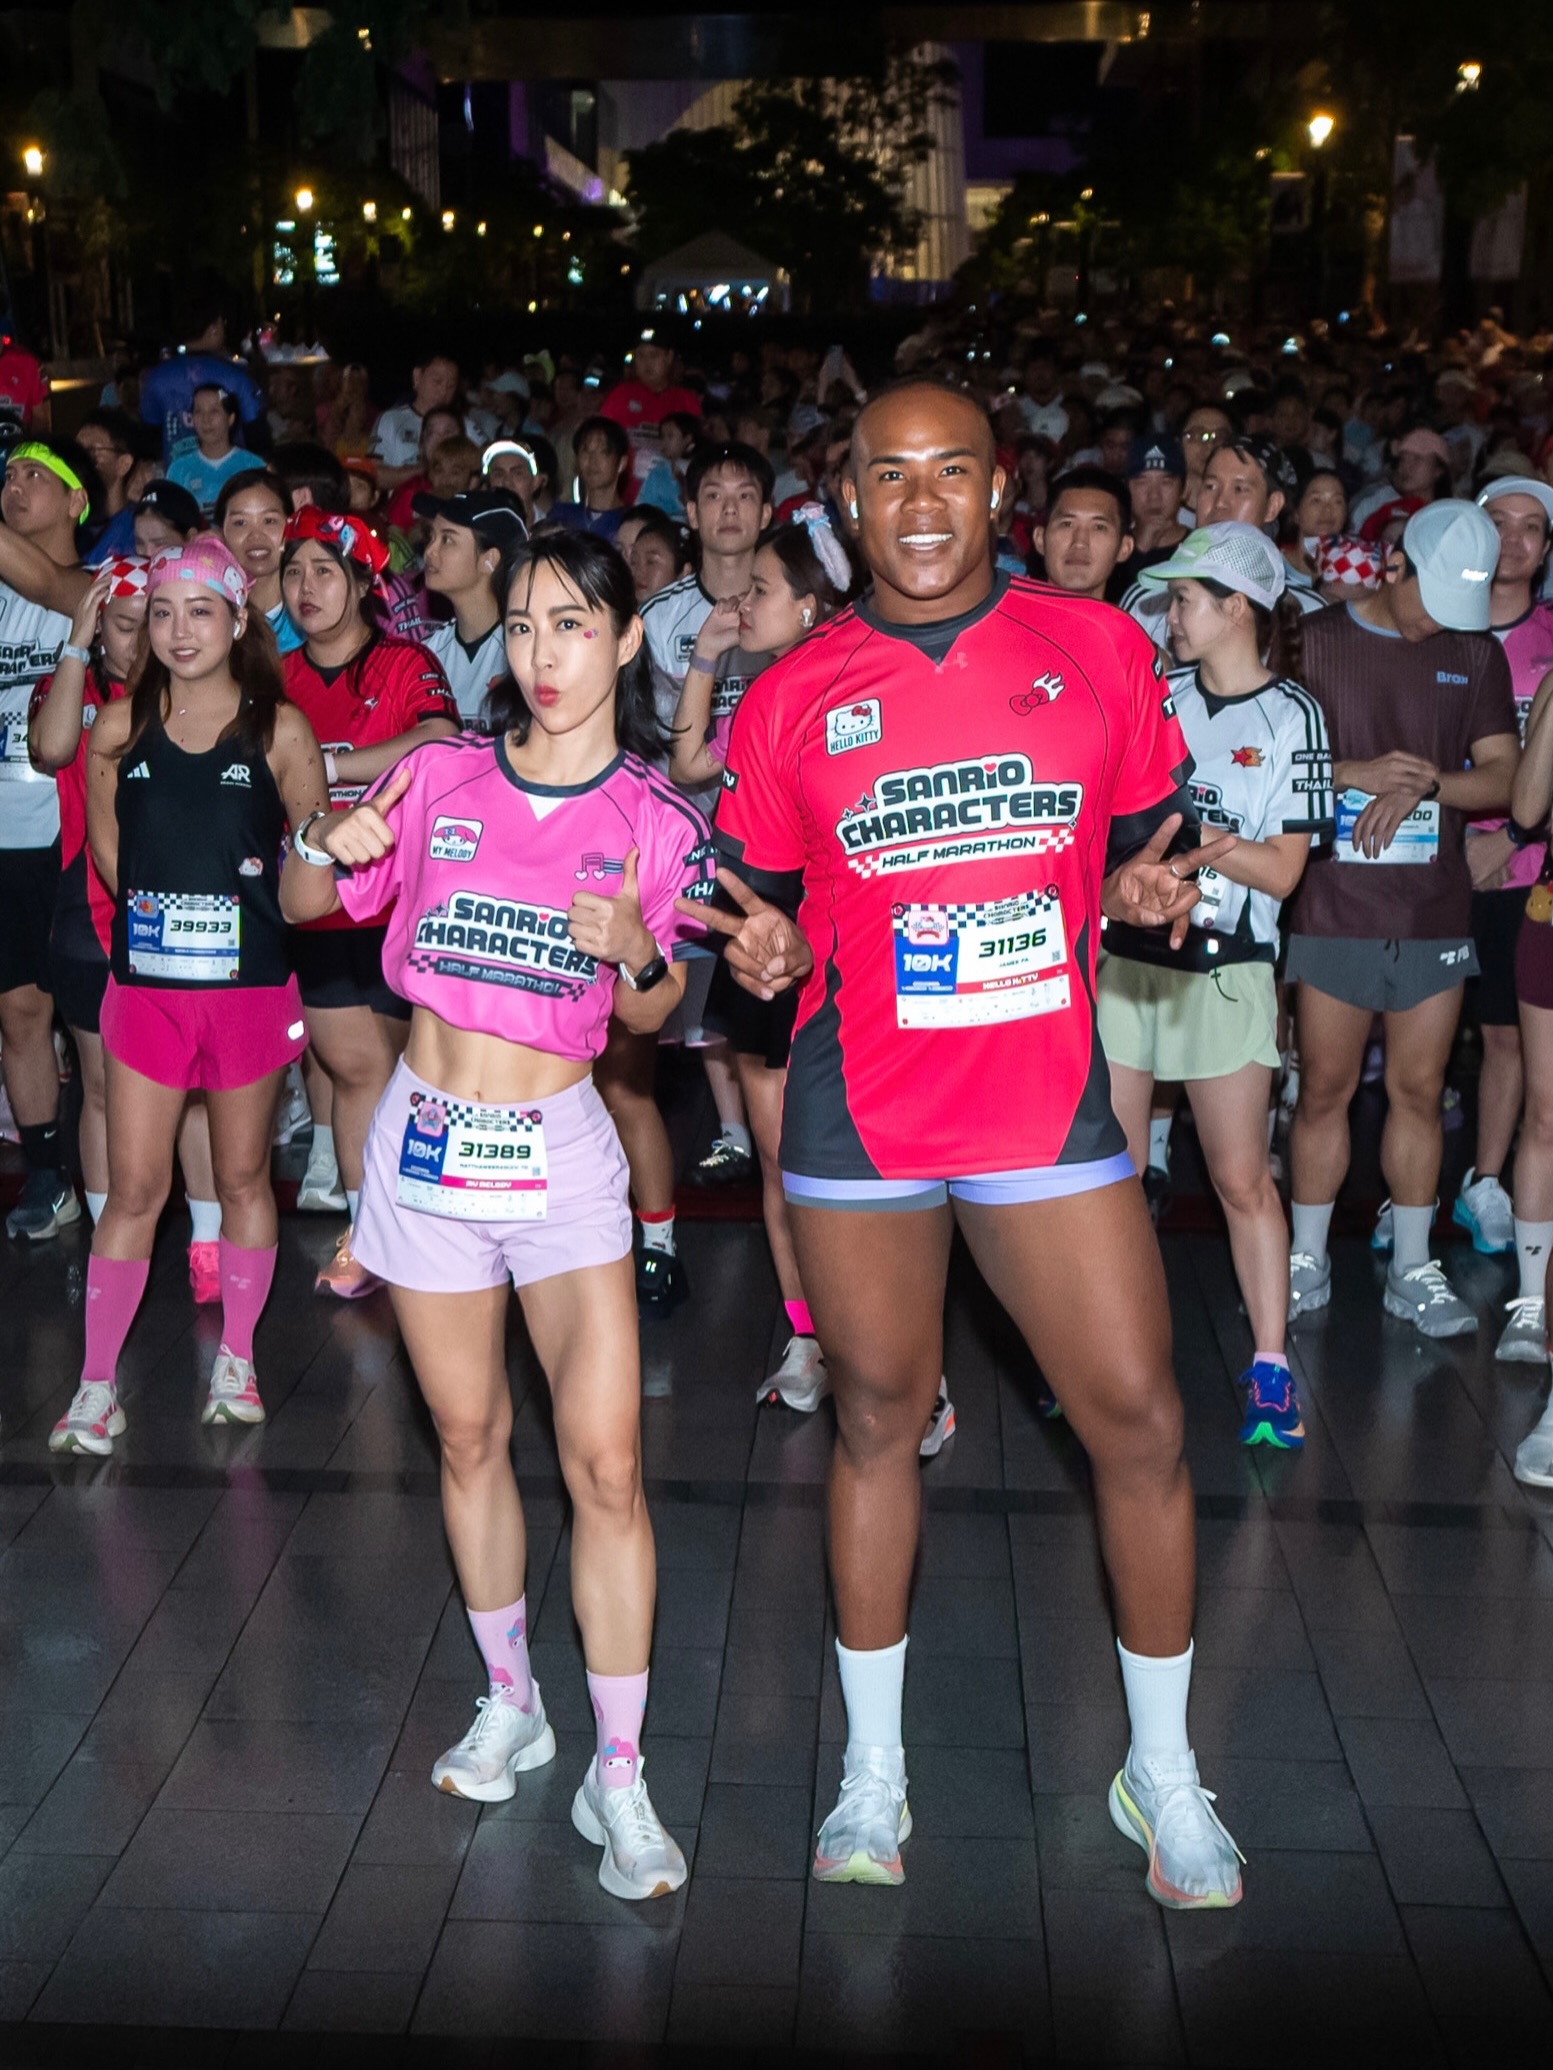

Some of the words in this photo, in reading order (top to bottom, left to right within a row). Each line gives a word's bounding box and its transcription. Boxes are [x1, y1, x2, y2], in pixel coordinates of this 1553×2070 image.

[830, 736, 853, 752] HELLO
[855, 729, 879, 744] KITTY
[1295, 753, 1314, 761] ONE
[842, 790, 1077, 848] CHARACTERS
[432, 845, 443, 855] MY
[444, 847, 472, 859] MELODY
[882, 850, 929, 868] HALF
[933, 836, 1036, 859] MARATHON
[133, 923, 160, 938] 10K
[170, 920, 231, 933] 39933
[978, 928, 1046, 958] 31136
[439, 960, 480, 978] HALF
[903, 954, 953, 972] 10K
[407, 1139, 442, 1163] 10K
[458, 1141, 532, 1159] 31389
